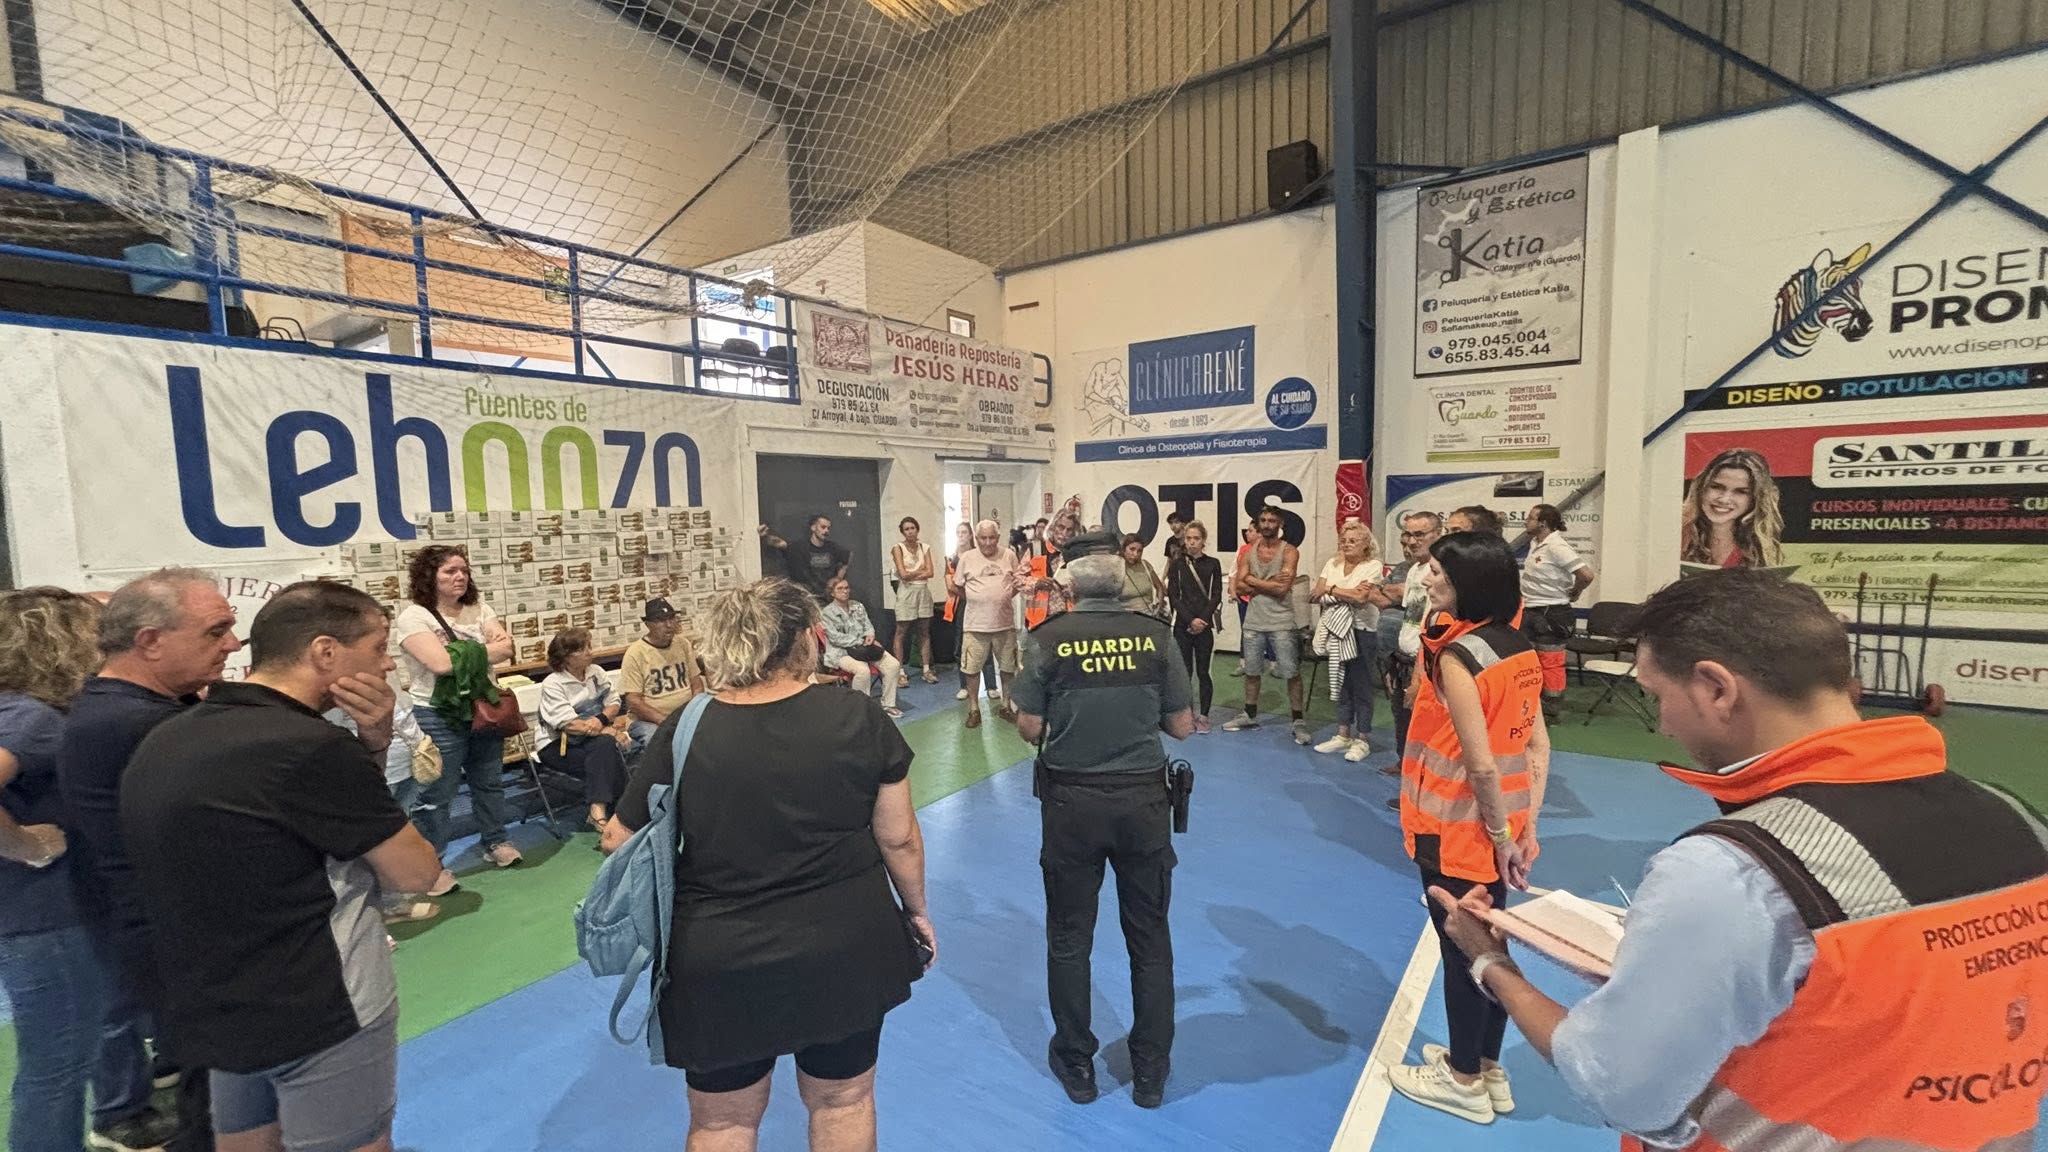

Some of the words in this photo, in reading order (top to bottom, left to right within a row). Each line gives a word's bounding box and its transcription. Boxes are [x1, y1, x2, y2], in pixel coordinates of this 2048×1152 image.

[1465, 206, 1480, 225] y
[1486, 188, 1576, 215] Estética
[1438, 228, 1545, 289] Katia
[1892, 247, 2048, 297] DISE
[885, 327, 956, 357] Panadería
[960, 342, 1022, 370] Repostería
[1448, 329, 1548, 350] 979.045.004
[1444, 343, 1551, 365] 655.83.45.44
[892, 355, 956, 383] JESÚS
[962, 366, 1020, 393] HERAS
[817, 379, 890, 402] DEGUSTACIÓN
[1467, 389, 1496, 397] DENTAL
[1727, 382, 1824, 406] DISEÑO
[1840, 367, 2029, 398] ROTULACIÓN
[563, 395, 587, 423] de
[978, 399, 1014, 415] OBRADOR
[1146, 444, 1156, 452] de
[1828, 438, 2048, 465] SANTIL
[1830, 466, 1957, 479] CENTROS
[1968, 465, 2006, 475] DE
[1101, 479, 1306, 554] OTIS
[1812, 500, 1877, 513] CURSOS
[1810, 517, 1931, 531] PRESENCIALES
[1057, 637, 1156, 657] GUARDIA
[1081, 655, 1137, 673] CIVIL
[1922, 904, 2035, 951] PROTECCIÓN
